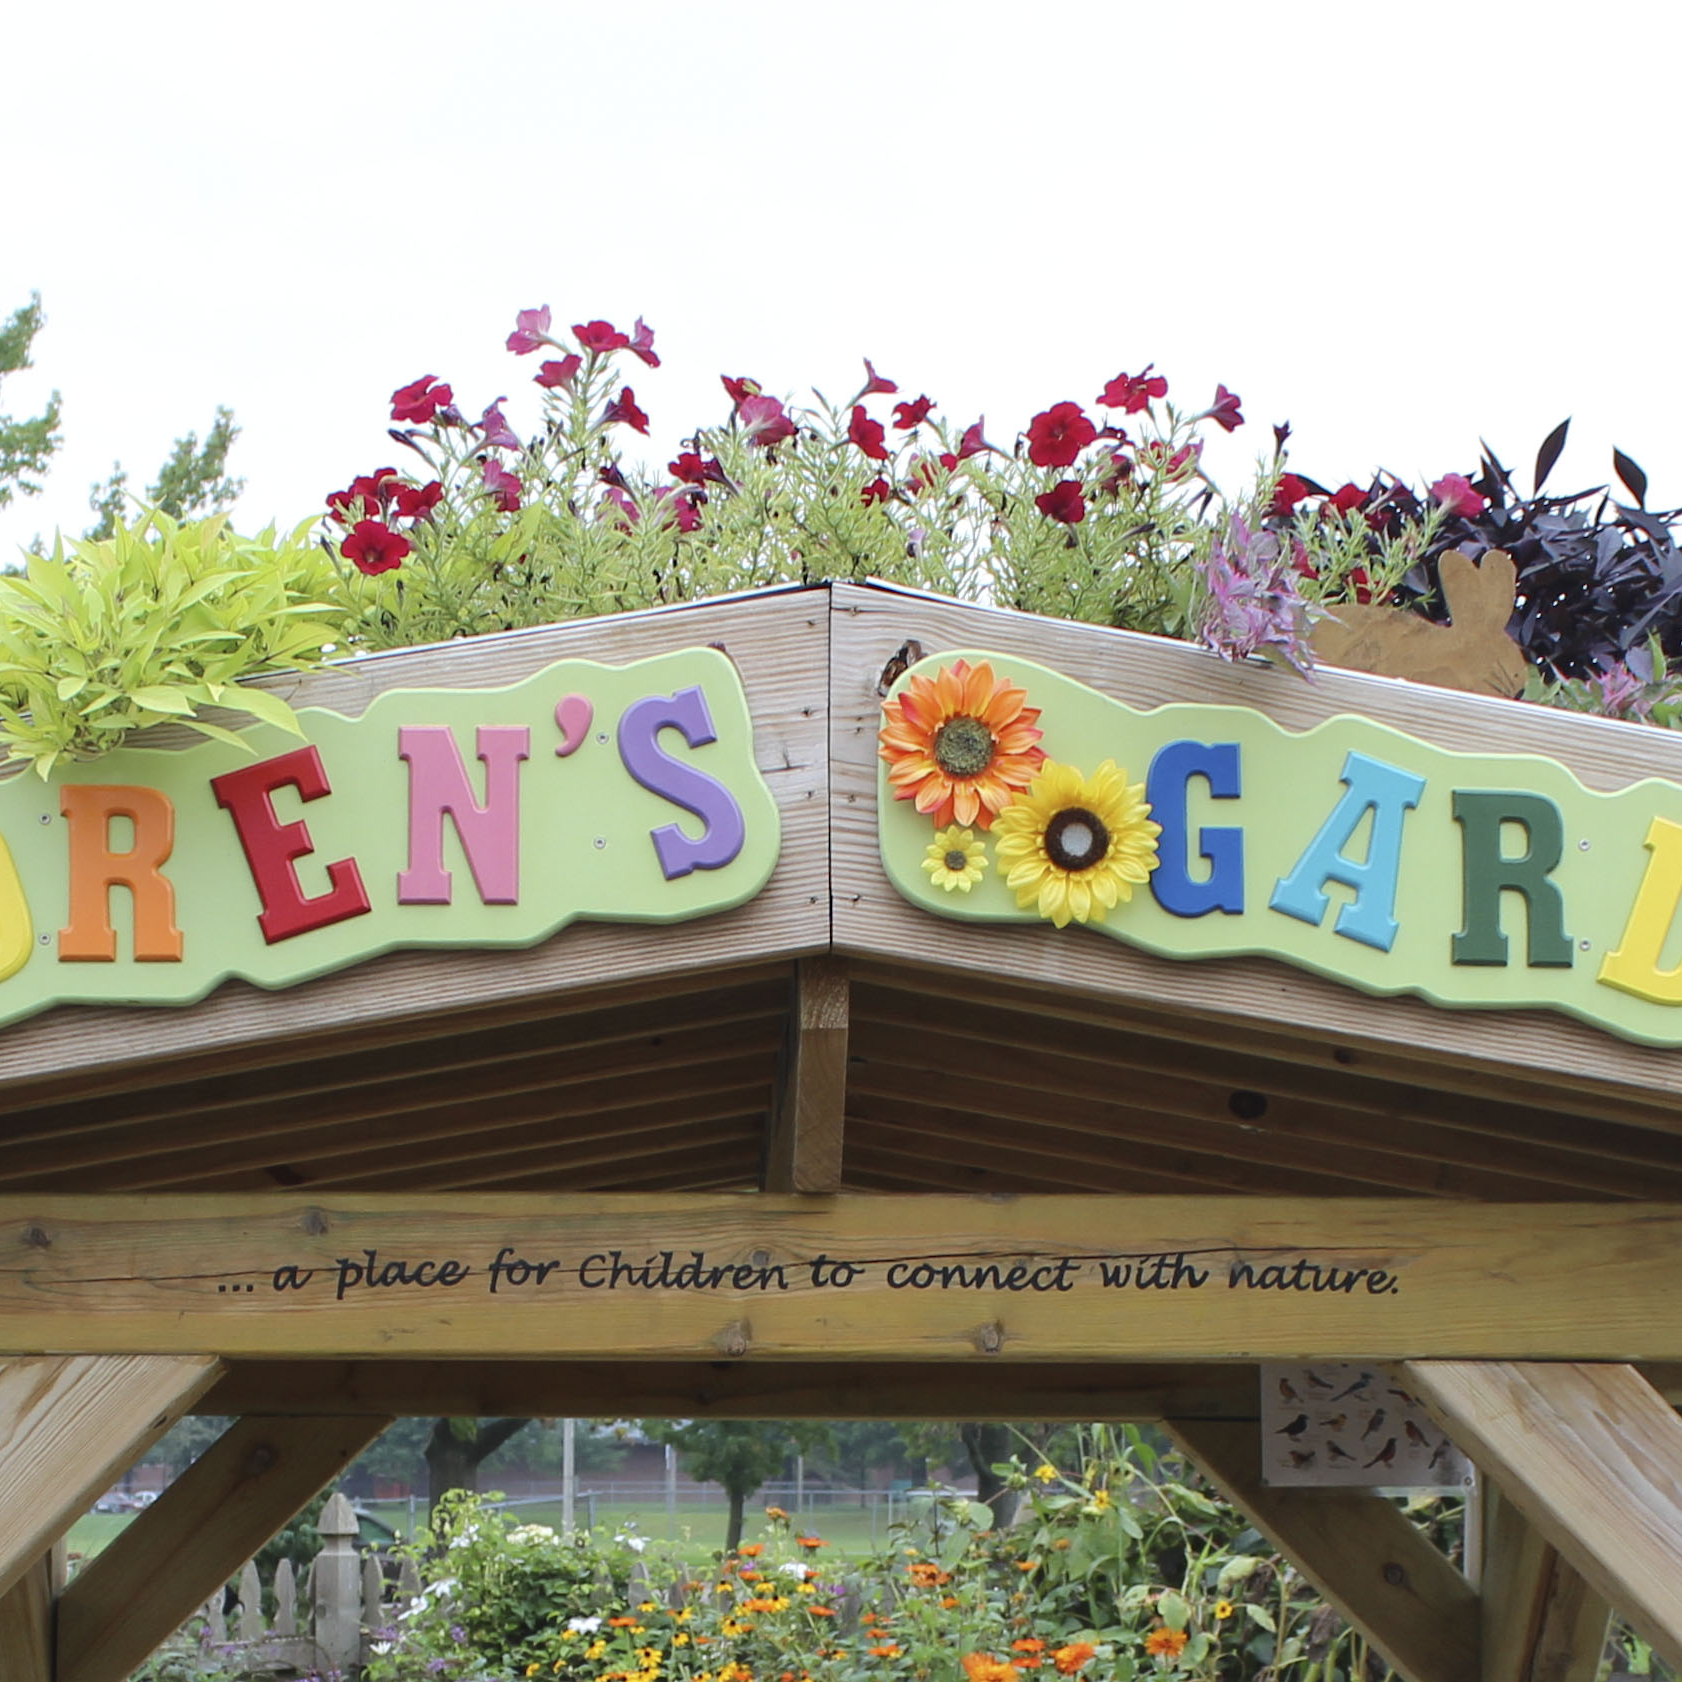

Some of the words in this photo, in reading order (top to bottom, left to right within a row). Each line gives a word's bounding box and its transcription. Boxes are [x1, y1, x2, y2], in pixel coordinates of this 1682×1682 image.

[335, 1249, 470, 1299] place
[489, 1247, 561, 1294] for
[578, 1249, 789, 1291] Children
[808, 1254, 865, 1288] to
[886, 1255, 1082, 1291] connect
[1100, 1252, 1210, 1291] with
[1228, 1257, 1400, 1295] nature.
